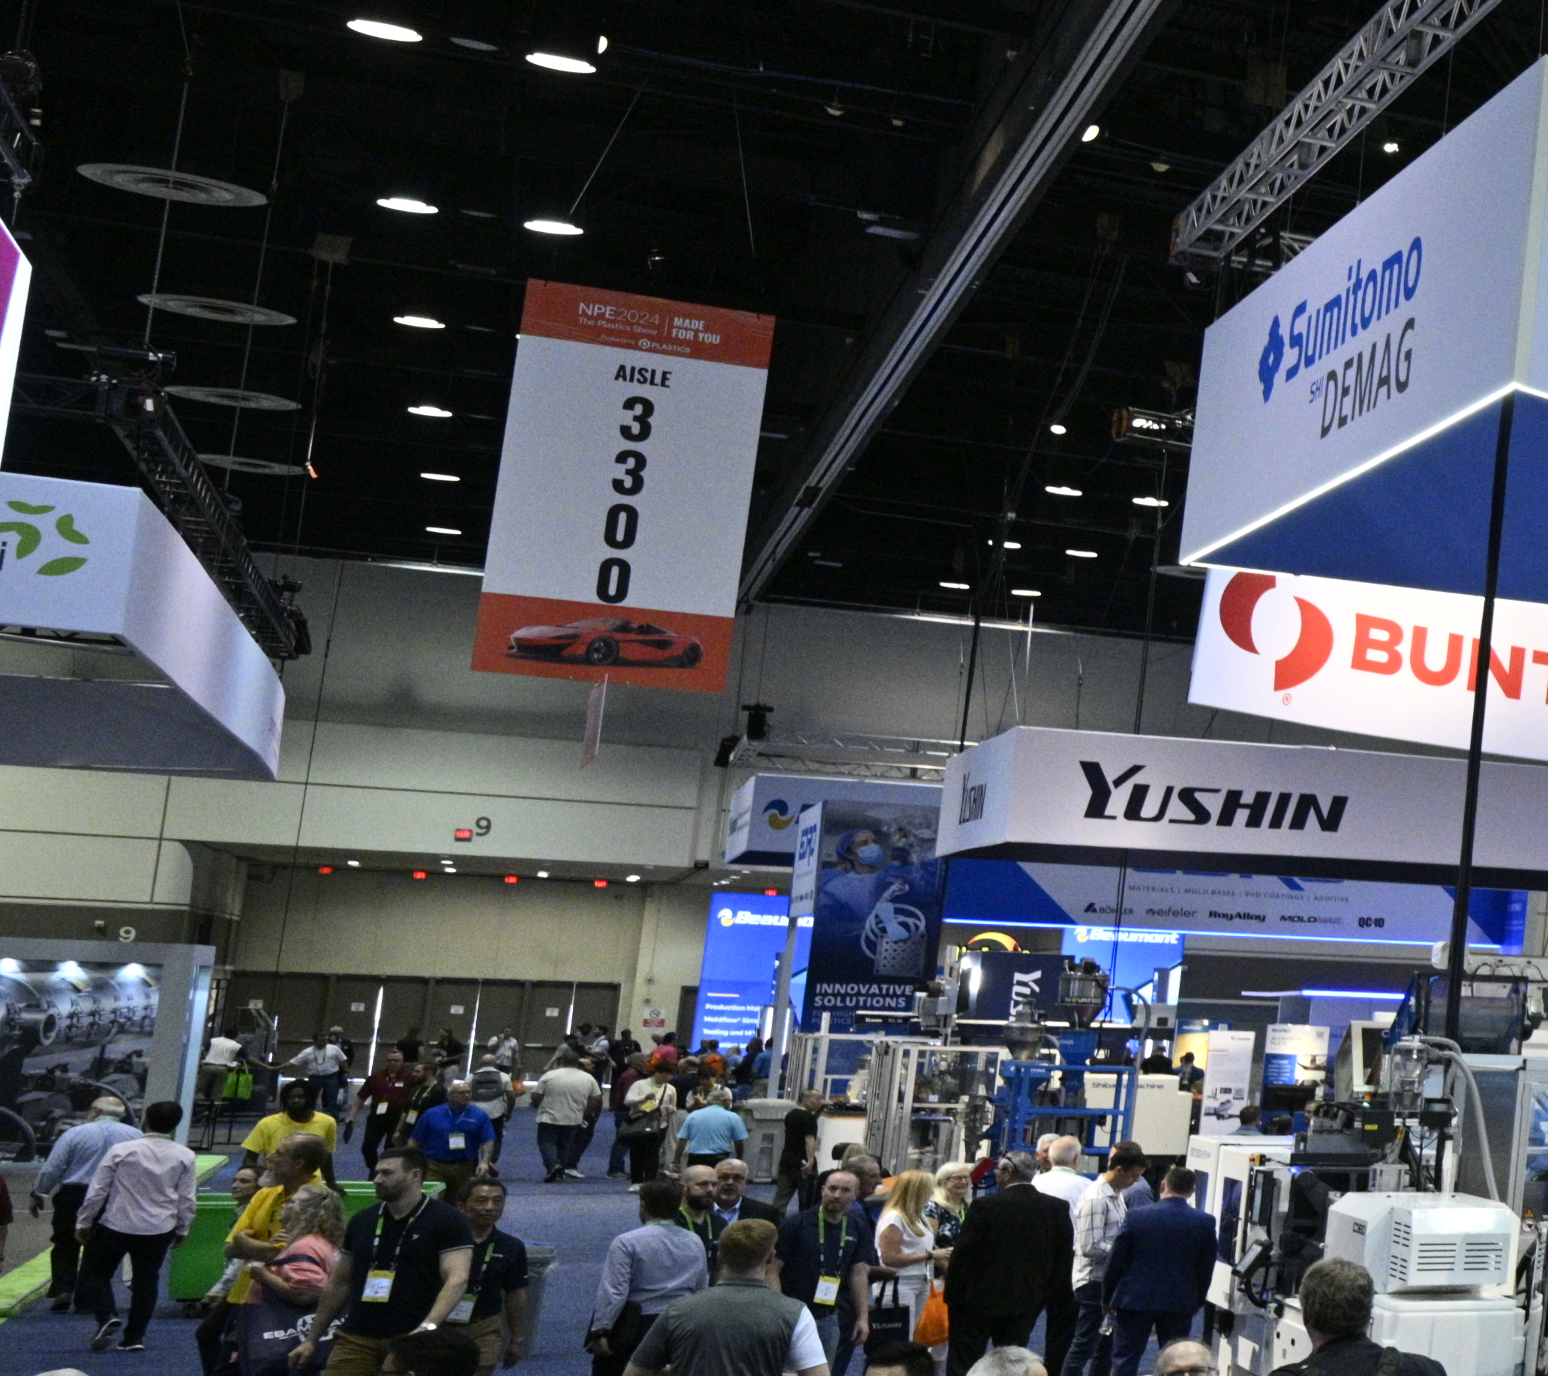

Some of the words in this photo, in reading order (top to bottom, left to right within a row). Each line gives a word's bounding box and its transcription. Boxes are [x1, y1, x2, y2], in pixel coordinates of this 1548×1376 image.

[578, 302, 661, 325] NPE2024
[1285, 236, 1423, 384] Sumitomo
[674, 316, 706, 331] MADE
[672, 328, 695, 341] FOR
[698, 331, 721, 345] YOU
[651, 342, 691, 354] PLASTICS
[614, 364, 672, 388] AISLE
[1308, 375, 1324, 404] SHI
[1320, 317, 1417, 440] DEMAG
[1078, 760, 1349, 832] YUSHIN
[475, 817, 492, 838] 9
[118, 926, 136, 943] 9
[815, 984, 913, 995] INNOVATIVE
[814, 996, 906, 1008] SOLUTIONS
